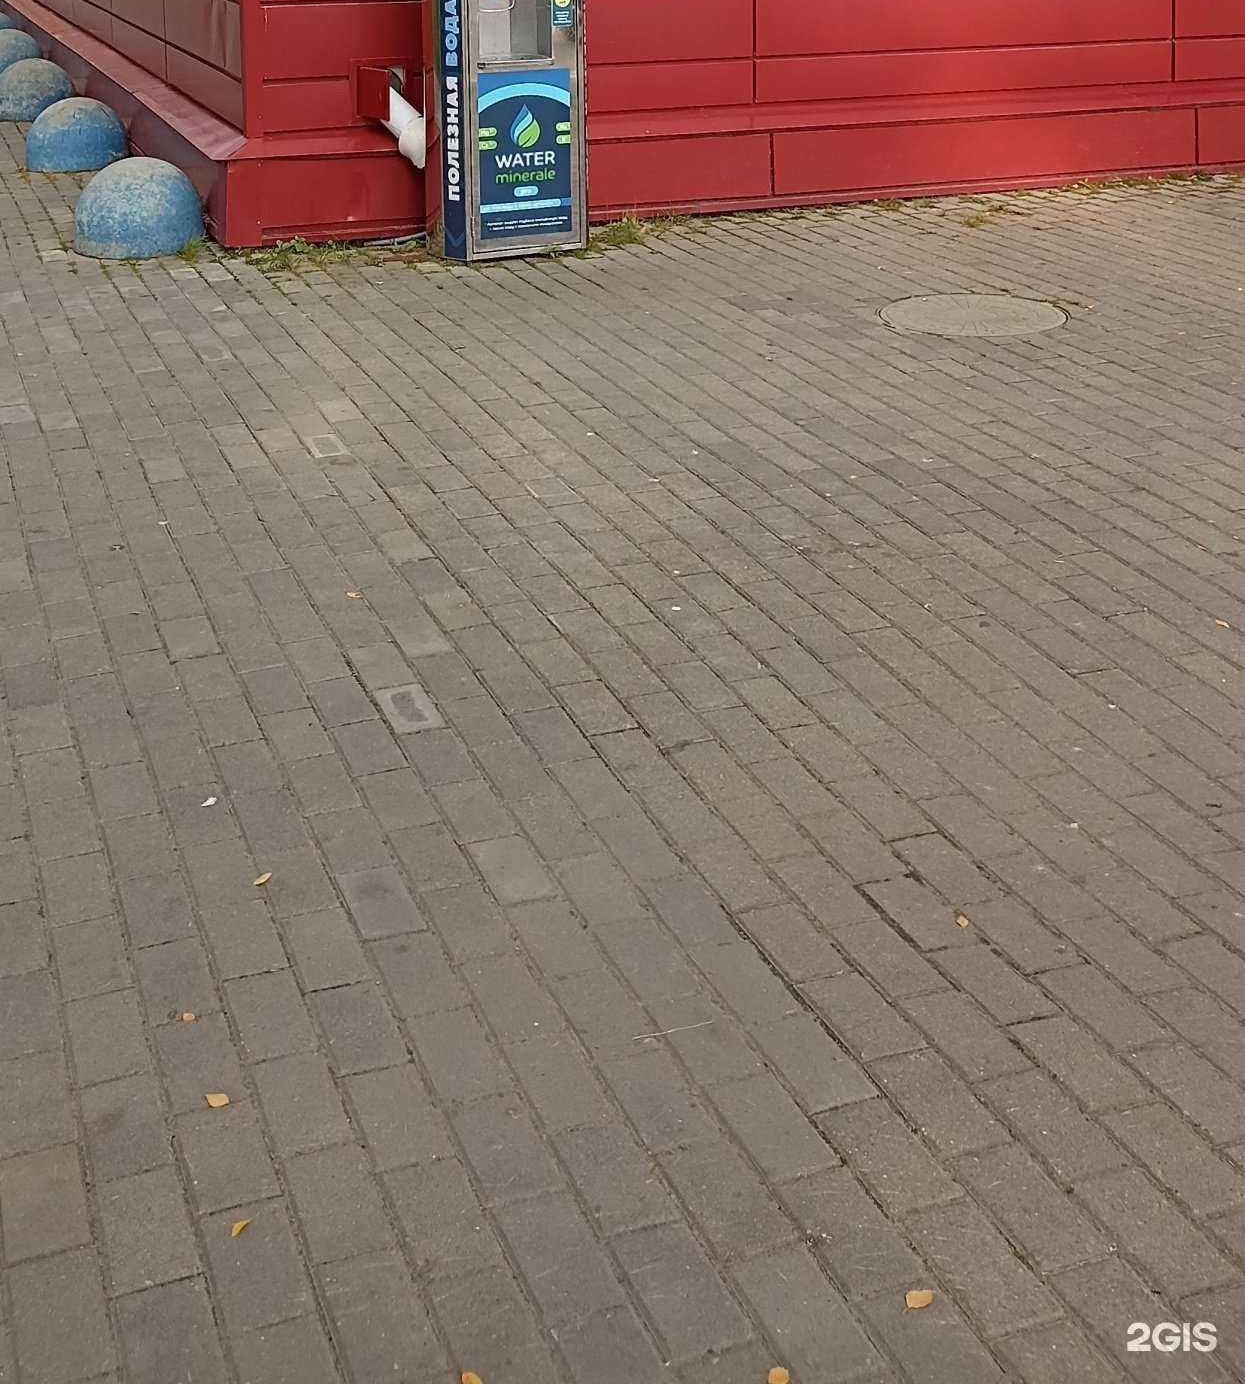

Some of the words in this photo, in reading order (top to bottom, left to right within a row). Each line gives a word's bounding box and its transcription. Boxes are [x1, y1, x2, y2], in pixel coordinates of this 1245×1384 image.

[445, 0, 460, 67] ВОДА
[446, 76, 460, 201] ПОЛЕЗНАЯ
[495, 150, 556, 169] WATER
[495, 167, 556, 184] minerale
